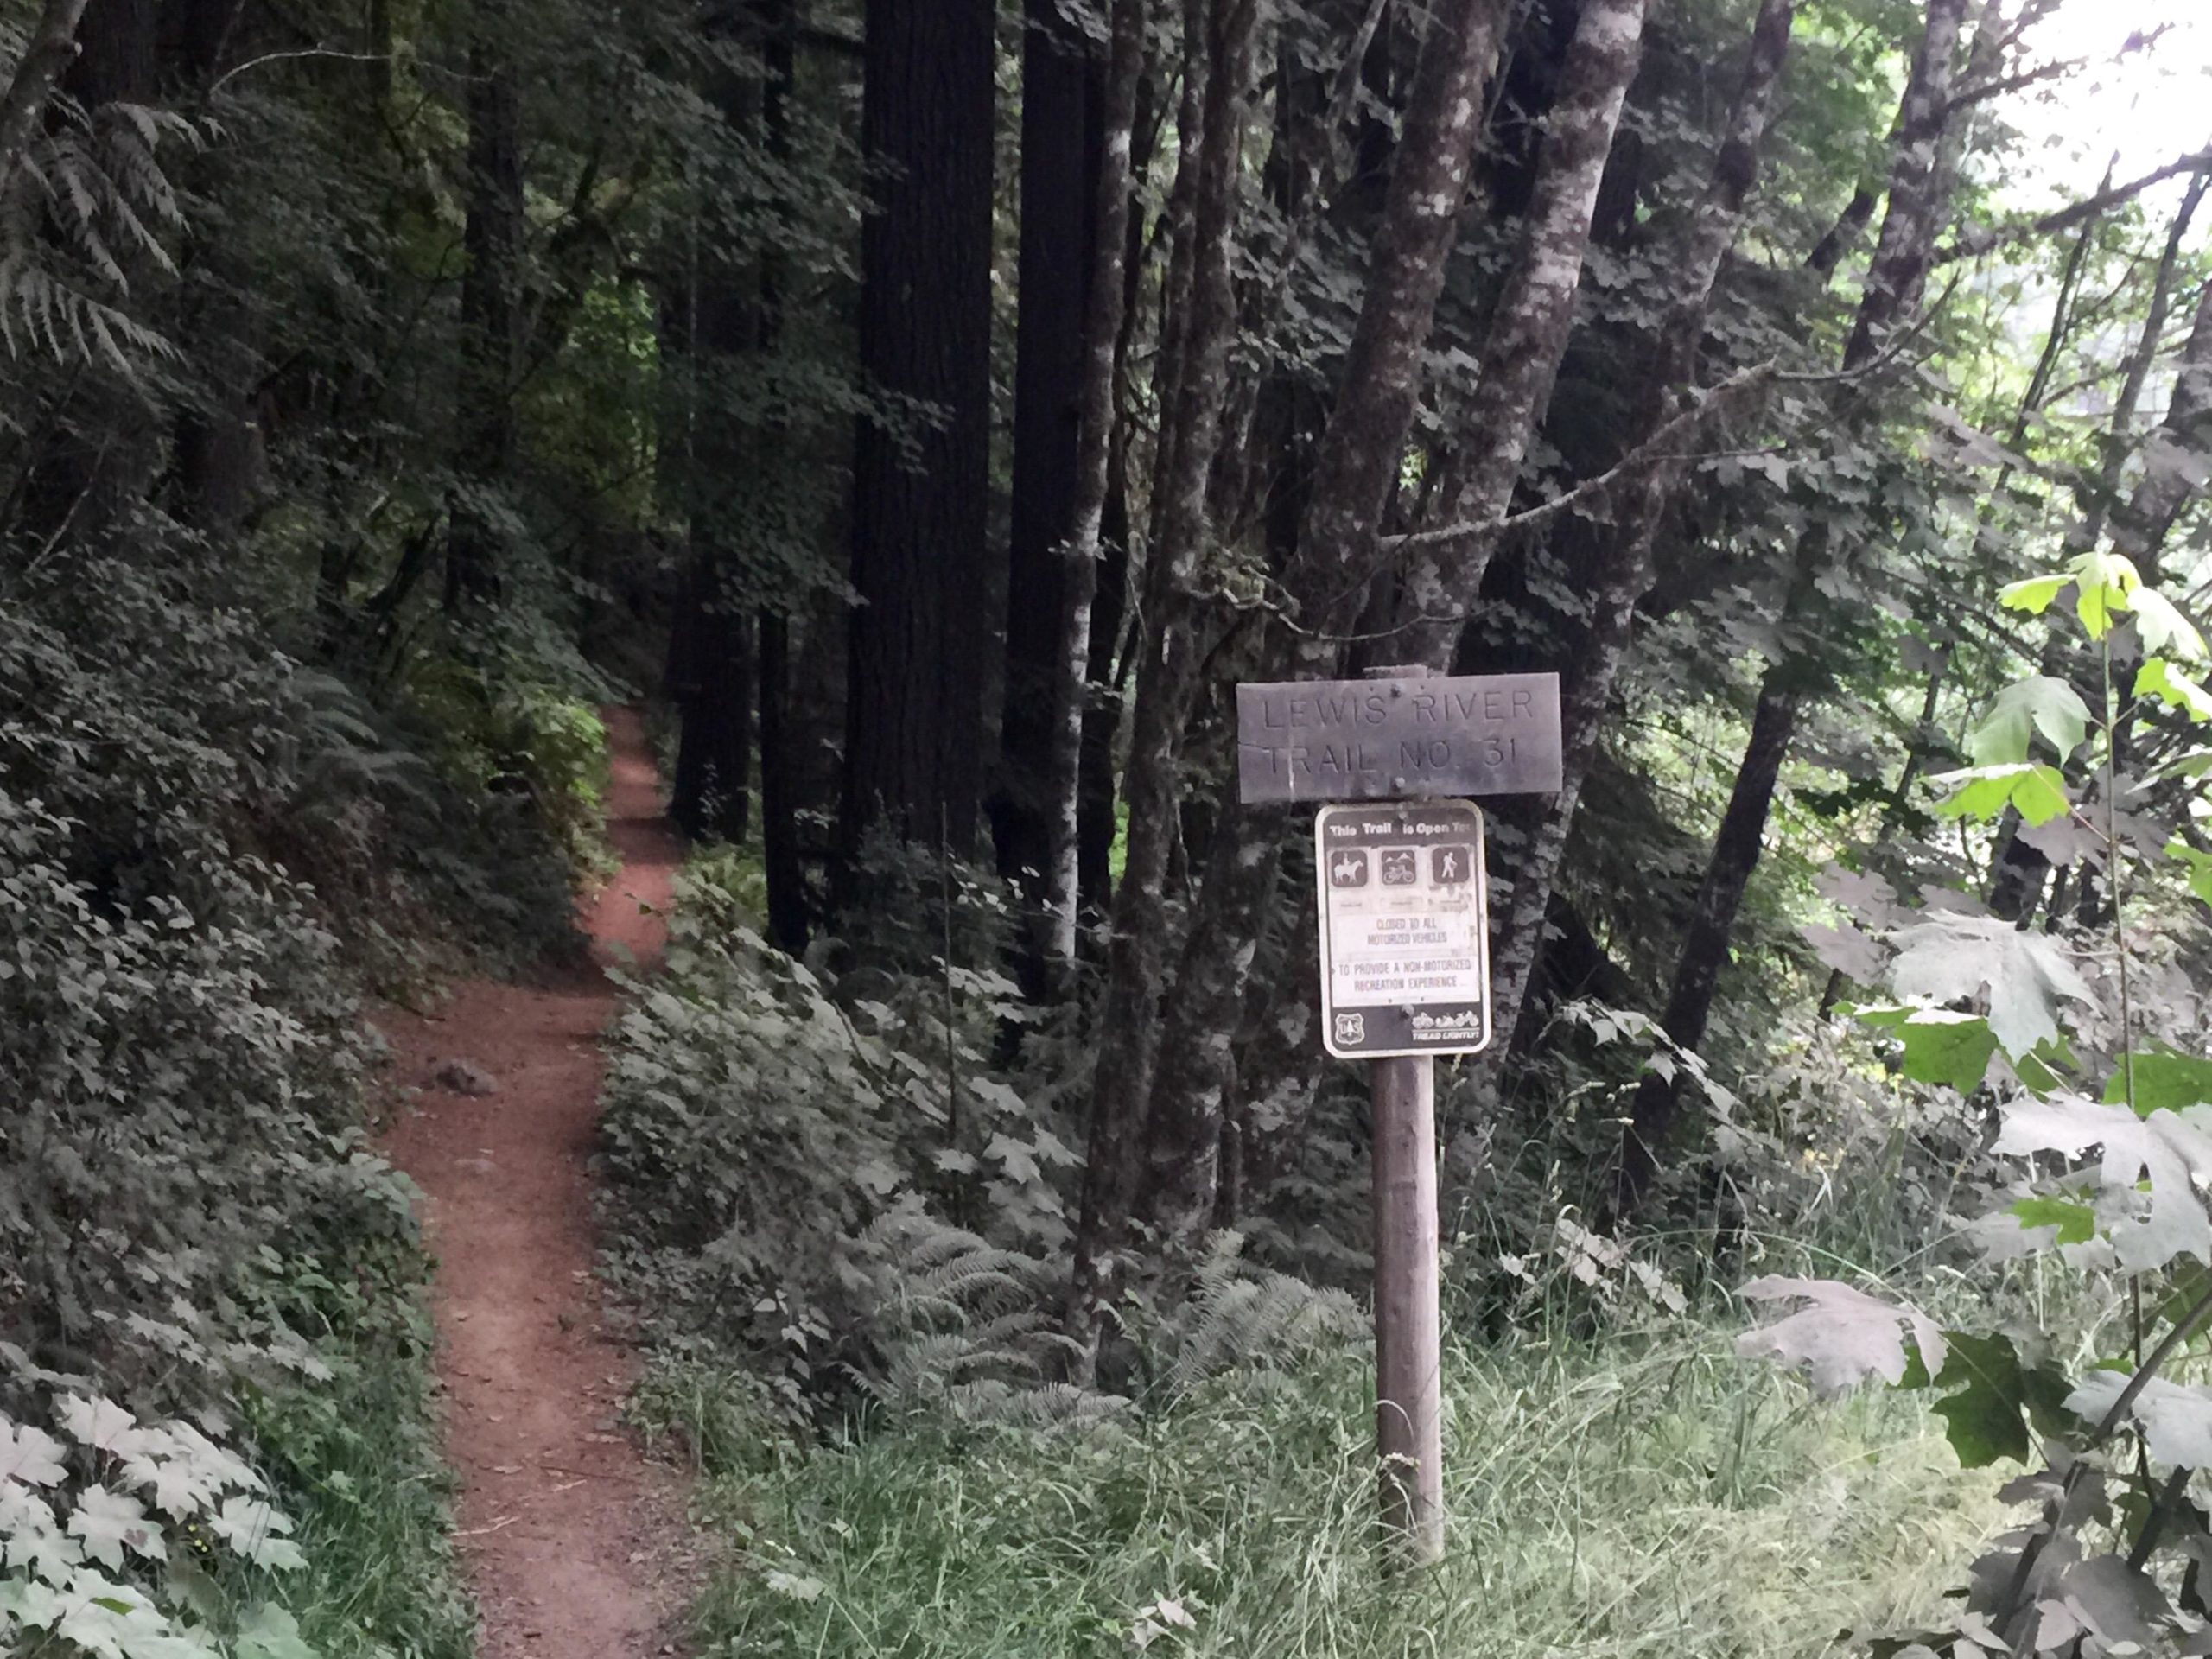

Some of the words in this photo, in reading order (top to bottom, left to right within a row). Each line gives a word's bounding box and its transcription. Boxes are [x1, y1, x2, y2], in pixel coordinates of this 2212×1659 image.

[1264, 695, 1387, 728] LEWIS
[1412, 690, 1533, 723] RIVER
[1263, 744, 1377, 774] TRAIL
[1483, 736, 1516, 767] 31
[1330, 824, 1357, 837] This
[1362, 822, 1392, 835] Trail
[1402, 823, 1414, 835] is
[1415, 822, 1450, 836] Open
[1376, 918, 1406, 931] CLOSED
[1409, 918, 1420, 930] TO
[1423, 917, 1438, 930] ALL
[1367, 932, 1411, 946] MOTORIZED
[1412, 931, 1448, 944] VEHICLES
[1338, 963, 1350, 976] TO
[1354, 962, 1390, 976] PROVIDE
[1394, 961, 1401, 973] A
[1403, 958, 1472, 973] NON-MOTORIZED
[1354, 977, 1405, 992] RECREATION
[1408, 975, 1458, 988] EXPERIENCE
[1413, 1031, 1442, 1041] TREAD
